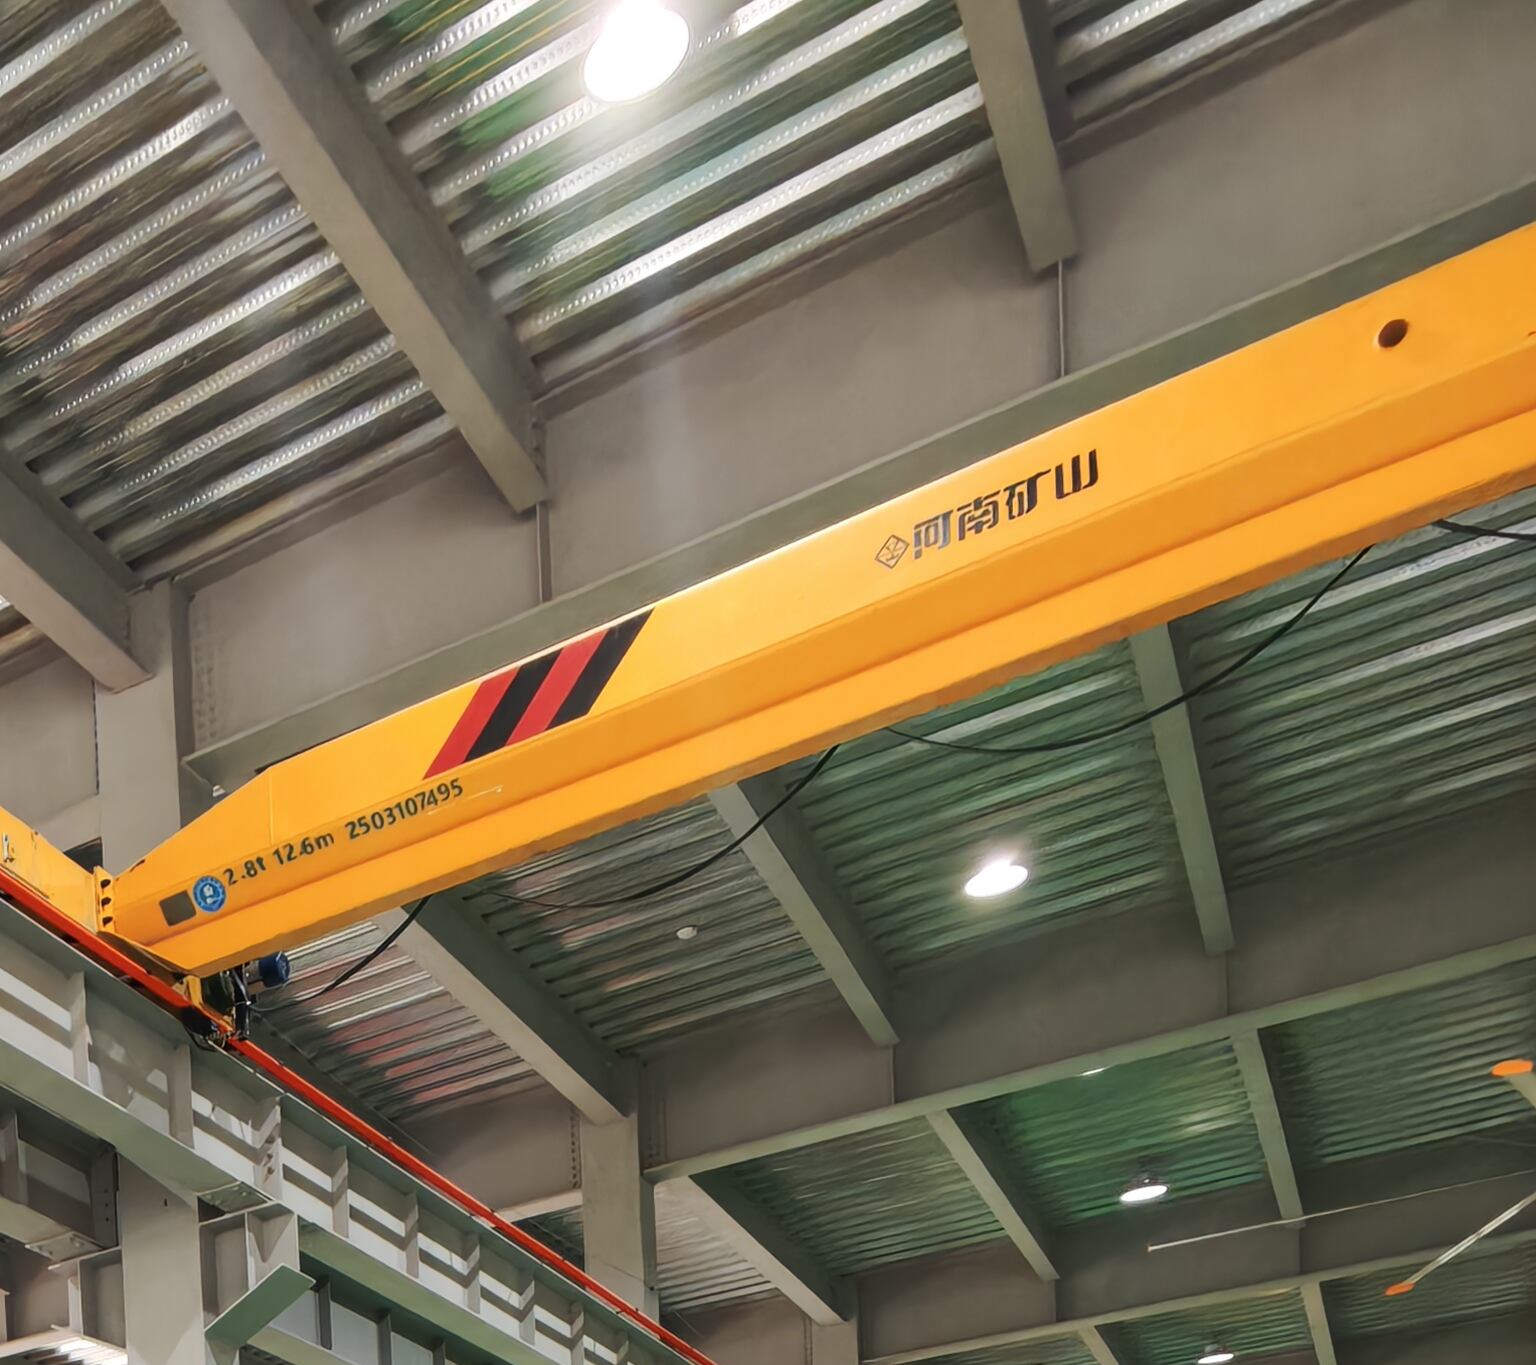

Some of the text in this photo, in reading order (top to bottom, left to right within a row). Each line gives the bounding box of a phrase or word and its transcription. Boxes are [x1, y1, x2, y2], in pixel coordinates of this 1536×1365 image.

[914, 449, 1099, 560] 河南矿山
[223, 778, 463, 886] 2.8t 12.6m 2503107495
